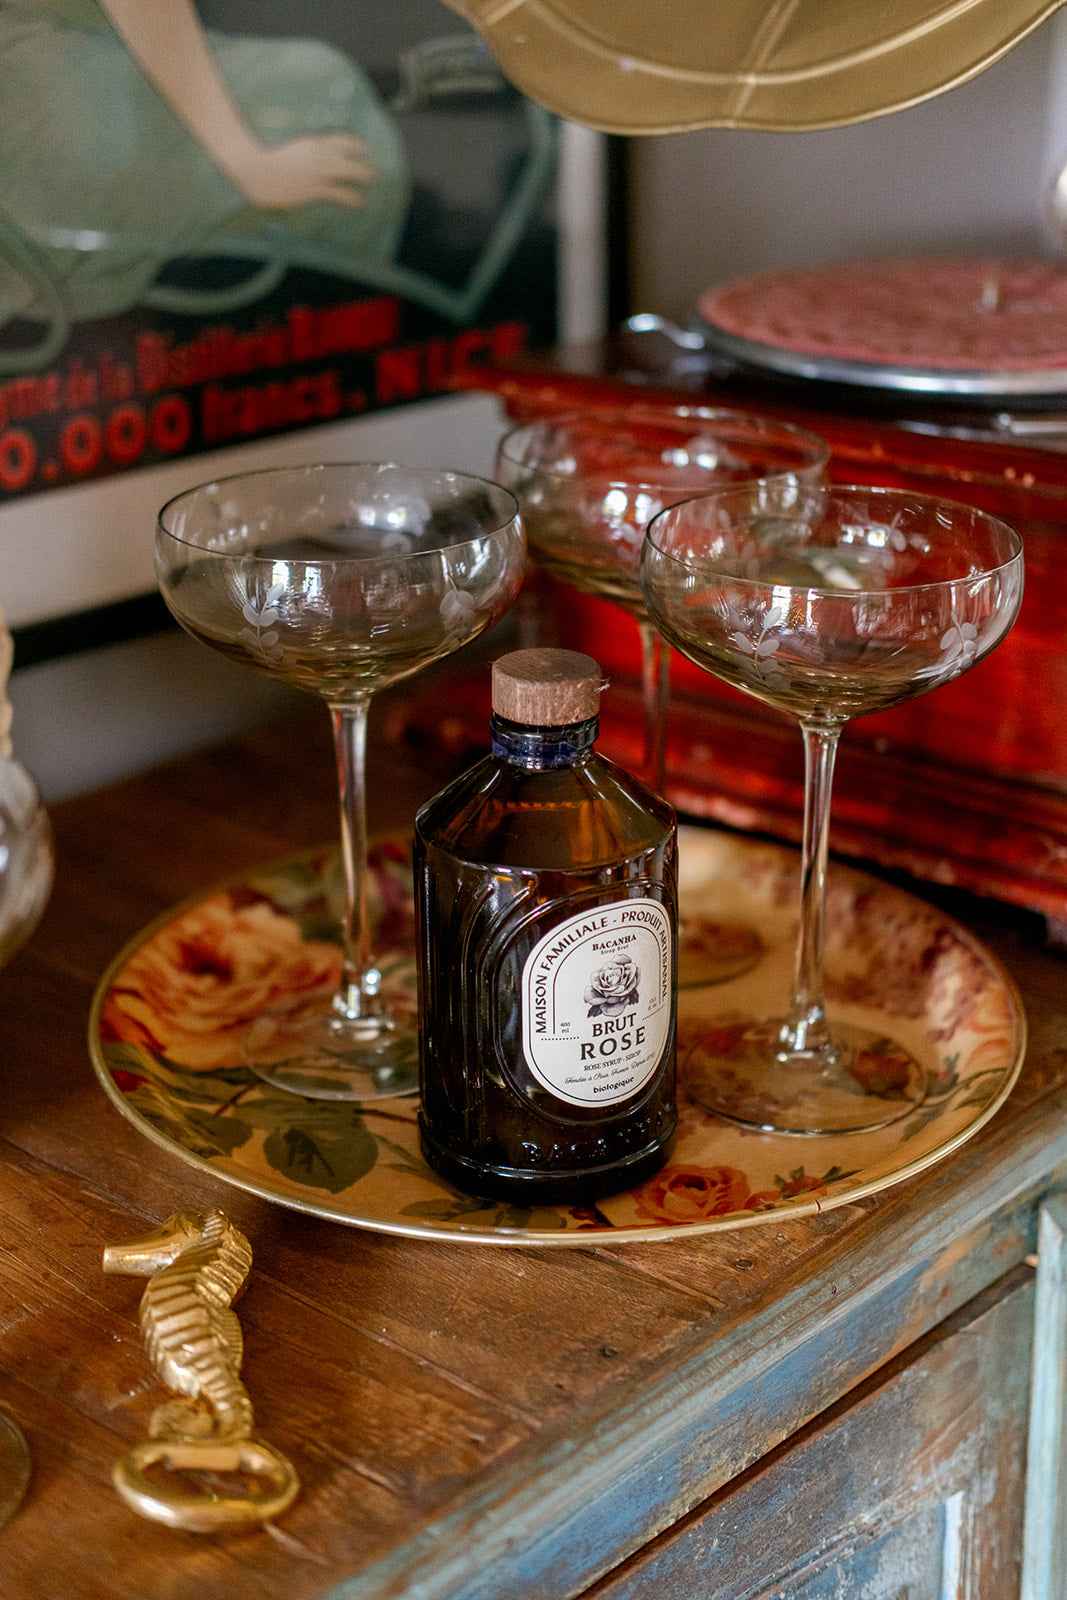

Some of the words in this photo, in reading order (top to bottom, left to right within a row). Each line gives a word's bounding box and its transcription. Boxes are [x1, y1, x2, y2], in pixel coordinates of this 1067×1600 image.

[592, 933, 637, 952] BACANHA
[535, 974, 547, 1034] MAISON
[541, 916, 609, 972] FAMILIALE
[621, 910, 663, 932] PRODUIT
[592, 1012, 637, 1038] BRUT
[580, 1026, 646, 1061] ROSE
[593, 1076, 635, 1094] biologique
